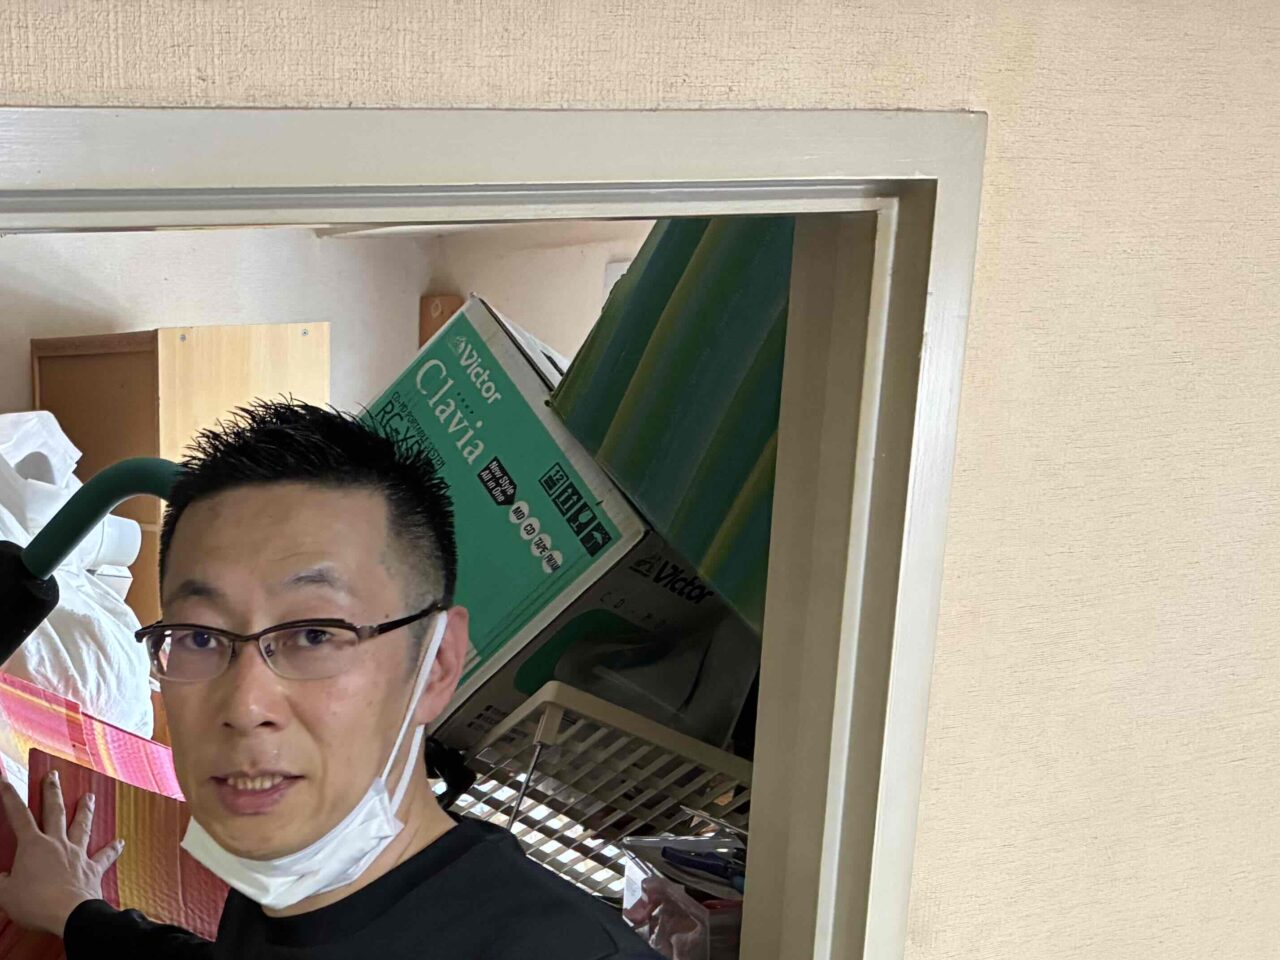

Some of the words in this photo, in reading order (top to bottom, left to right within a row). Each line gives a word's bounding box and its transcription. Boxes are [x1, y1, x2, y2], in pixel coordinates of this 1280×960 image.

[458, 343, 502, 405] Victor
[414, 358, 485, 465] Clavia
[480, 468, 492, 482] All
[491, 486, 507, 503] One
[488, 460, 502, 477] New
[497, 474, 516, 497] Style
[552, 468, 565, 483] 12
[511, 505, 527, 521] MD
[522, 521, 537, 537] CD
[532, 536, 549, 556] TAPE
[652, 559, 714, 604] Victor
